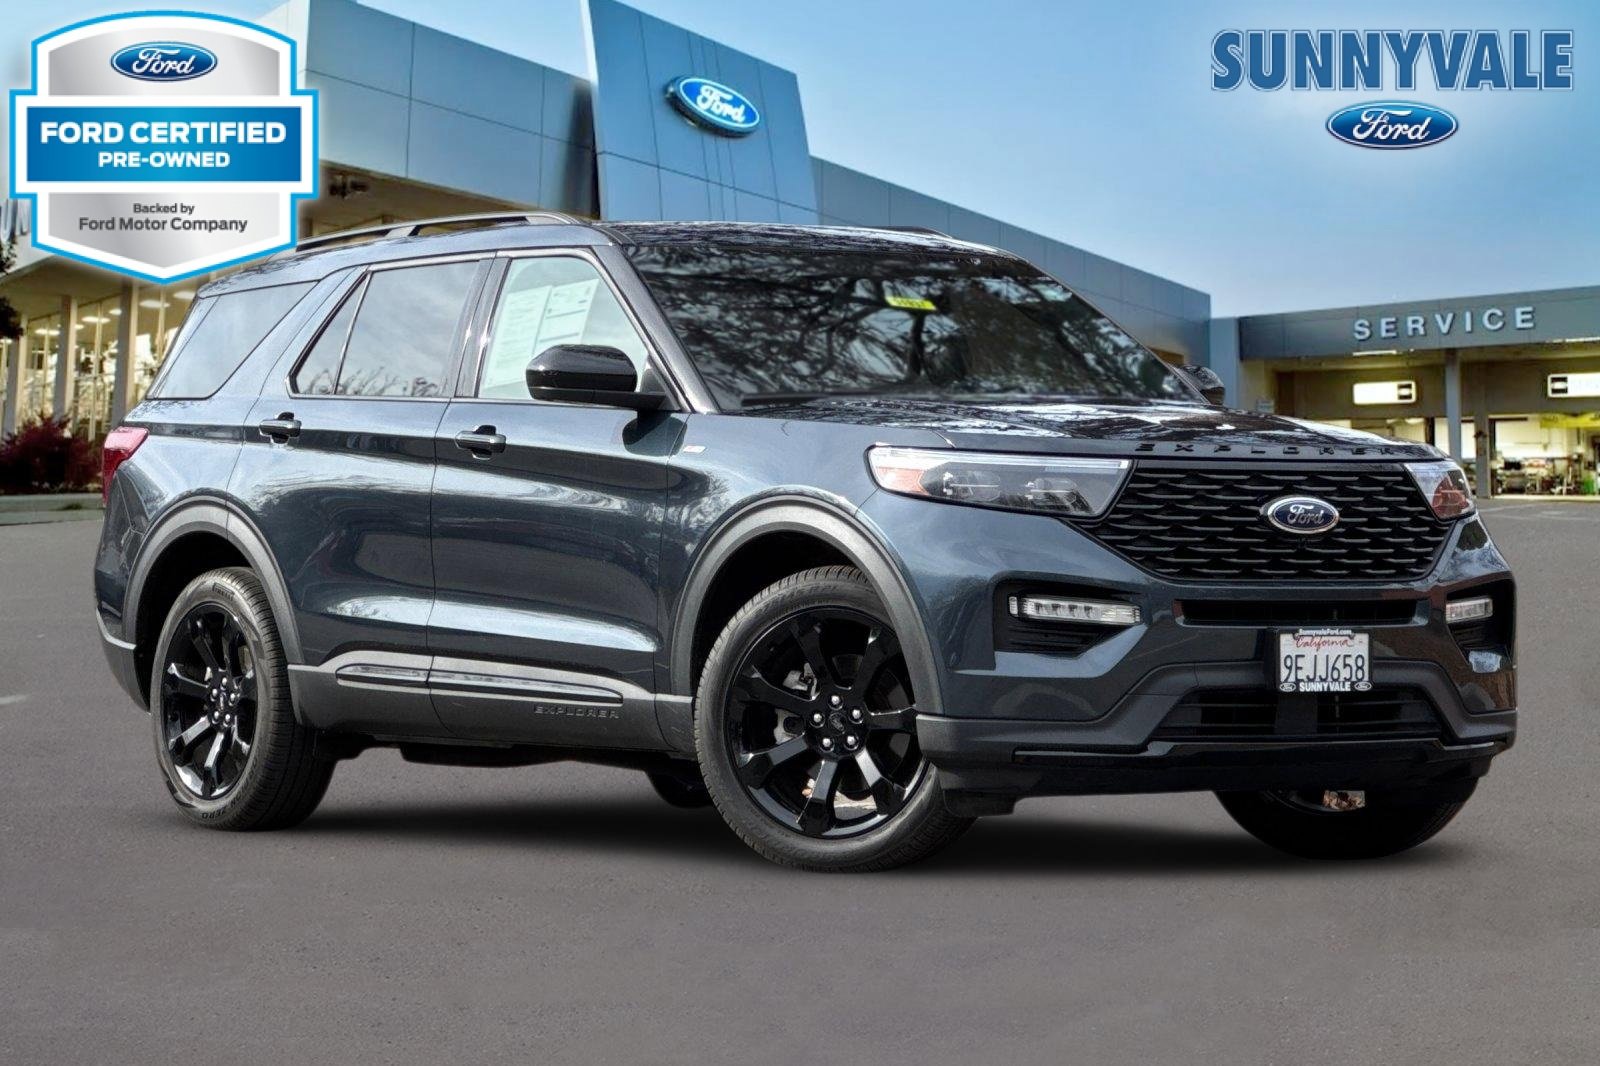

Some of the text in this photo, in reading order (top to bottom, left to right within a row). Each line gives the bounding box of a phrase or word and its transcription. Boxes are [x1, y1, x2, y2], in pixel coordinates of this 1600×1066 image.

[696, 85, 746, 123] Ford
[1353, 306, 1536, 340] SERVICE
[1286, 504, 1326, 525] Ford
[1295, 635, 1354, 651] California
[1283, 654, 1365, 682] 9EJJ658
[1299, 682, 1352, 692] SUNNYVALE
[534, 705, 620, 719] EXPLORER
